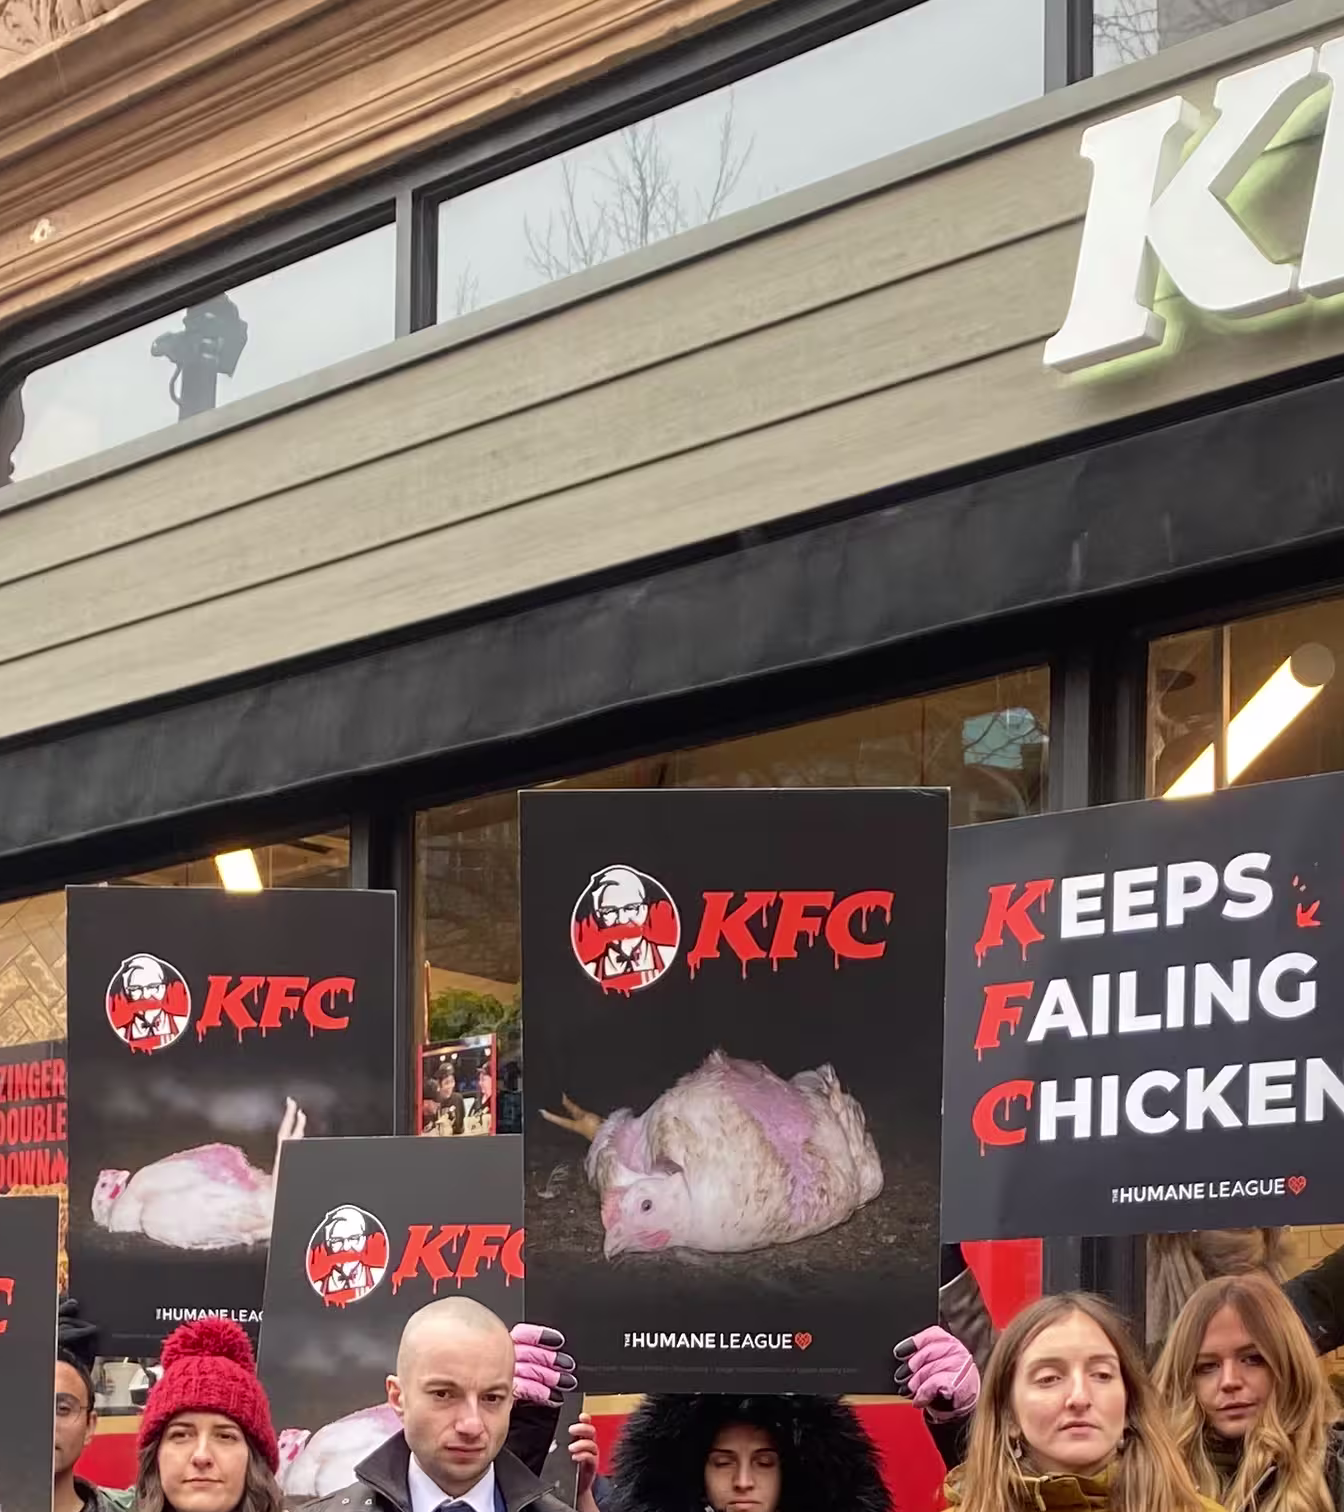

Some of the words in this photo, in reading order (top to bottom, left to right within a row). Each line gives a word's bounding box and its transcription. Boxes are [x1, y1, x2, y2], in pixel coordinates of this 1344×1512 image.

[688, 891, 893, 972] KFC
[975, 852, 1274, 968] KEEPS
[196, 976, 354, 1036] KFC
[973, 951, 1318, 1062] FAILING
[1120, 1183, 1204, 1203] HUMANE
[1209, 1178, 1285, 1198] LEAGUE
[633, 1333, 715, 1348] HUMANE
[721, 1334, 792, 1348] LEAGUE
